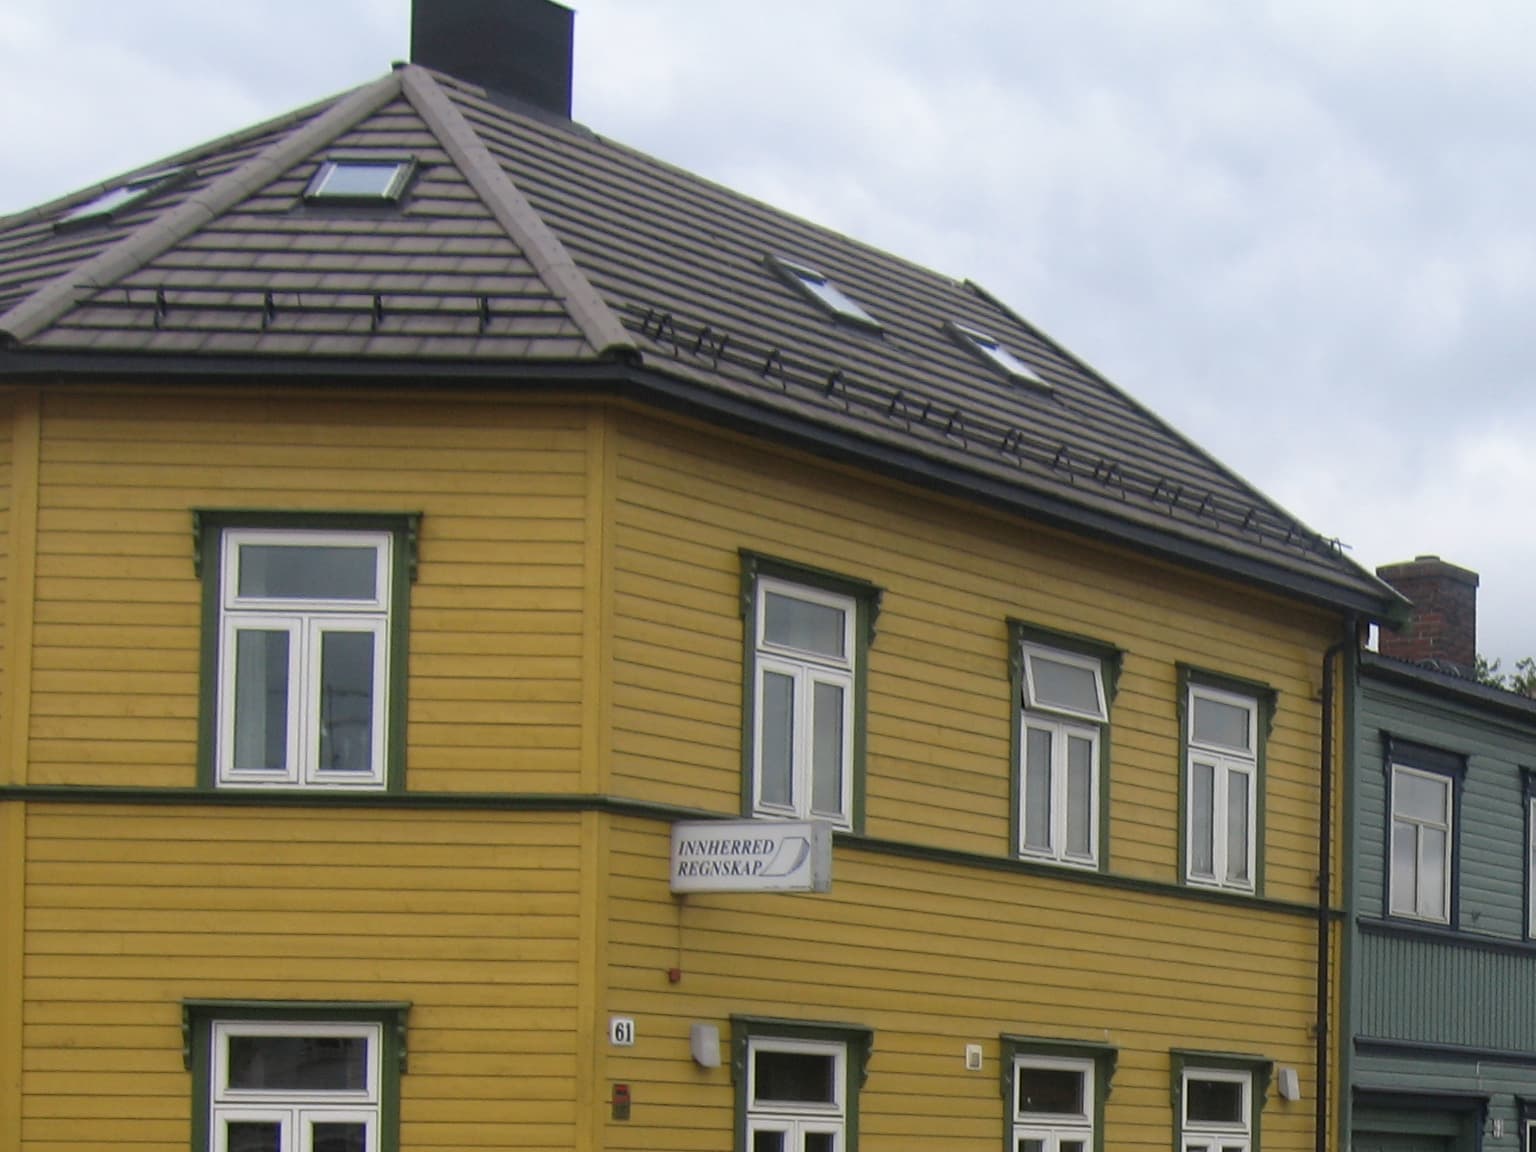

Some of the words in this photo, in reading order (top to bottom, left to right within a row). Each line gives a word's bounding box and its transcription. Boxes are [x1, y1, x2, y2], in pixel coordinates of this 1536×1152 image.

[678, 838, 775, 857] INNHERRED
[677, 861, 763, 878] REGNSKAP
[615, 1021, 632, 1043] 61
